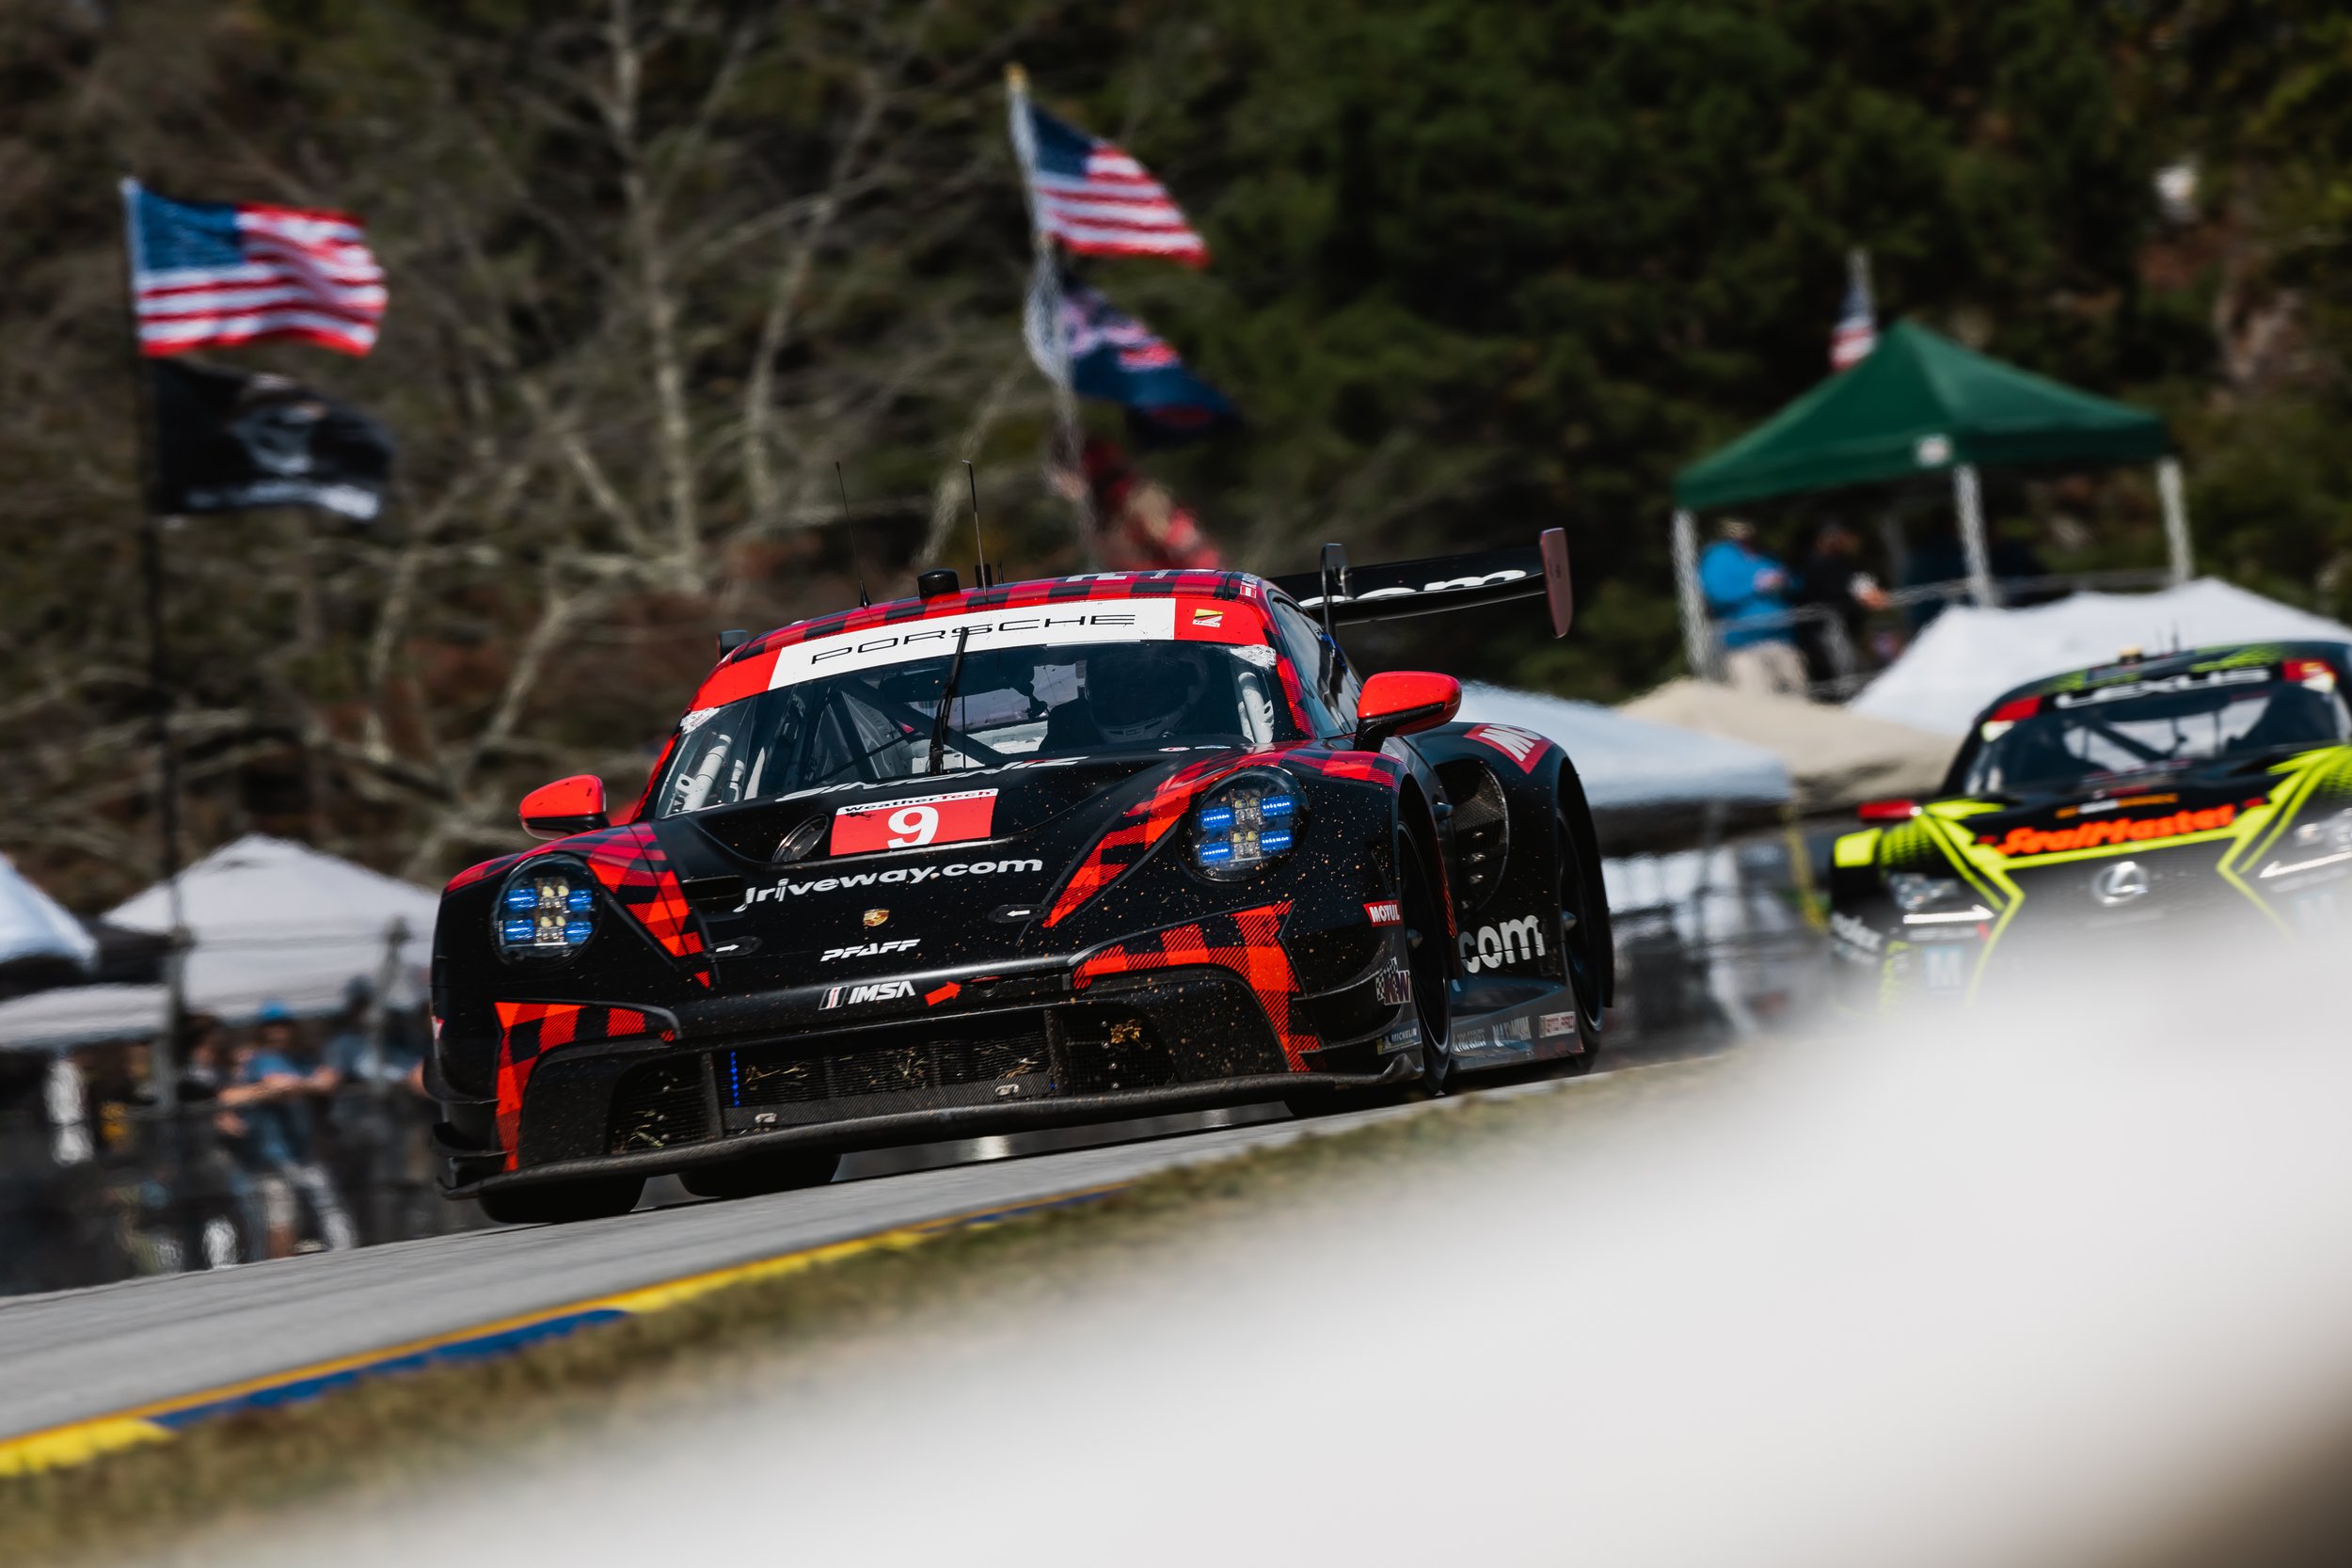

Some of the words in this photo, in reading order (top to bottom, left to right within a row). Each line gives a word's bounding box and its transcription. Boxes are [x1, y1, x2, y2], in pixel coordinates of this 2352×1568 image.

[811, 613, 1136, 665] PORSCHE
[845, 789, 991, 813] WeatherTech
[887, 805, 940, 849] 9
[1369, 904, 1400, 923] MOTUL
[819, 938, 921, 962] PFAFF
[848, 980, 916, 1005] IMSA
[1391, 1027, 1418, 1043] MICHELIN
